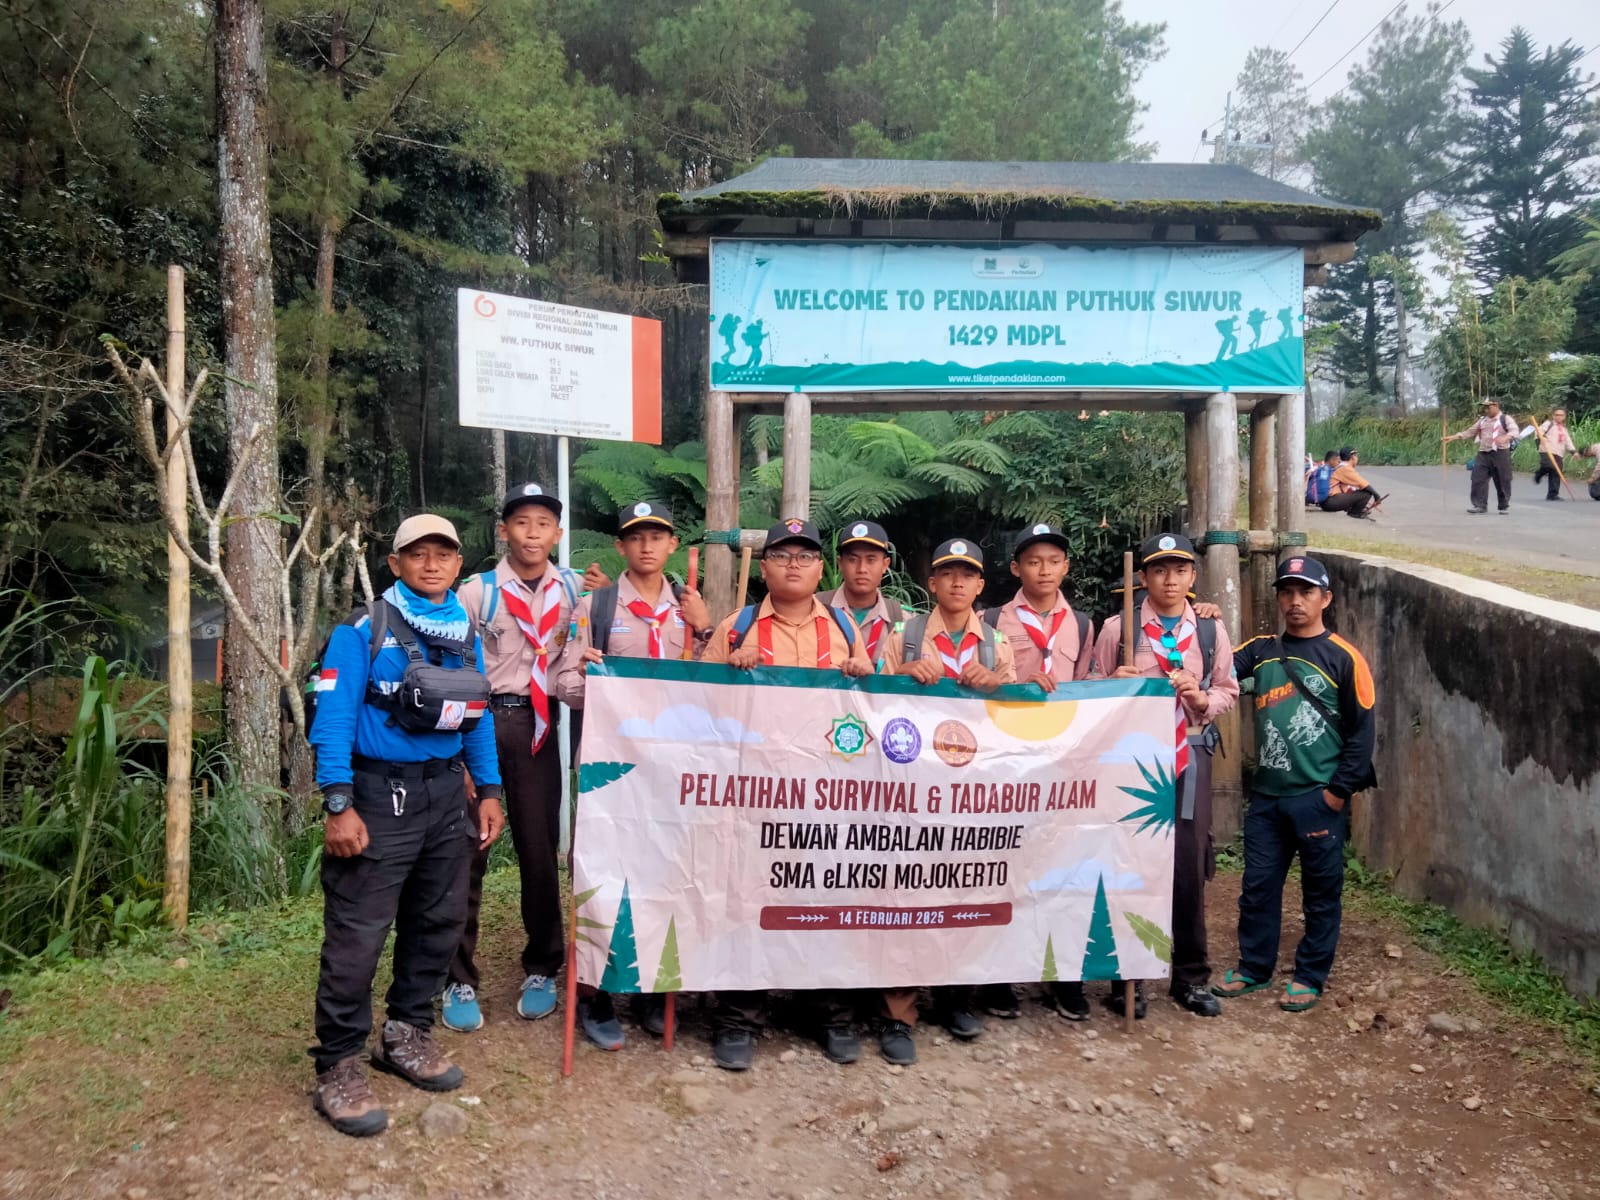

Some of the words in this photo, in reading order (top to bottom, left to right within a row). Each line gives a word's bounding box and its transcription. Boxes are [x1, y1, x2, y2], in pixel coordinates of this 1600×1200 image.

[773, 288, 889, 311] WELCOME
[895, 289, 925, 311] TO
[933, 289, 1057, 312] PENDAKIAN
[1065, 290, 1156, 312] PUTHUK
[1163, 290, 1243, 312] SIWUR
[533, 313, 571, 325] REGIONAL
[573, 319, 594, 329] JAWA
[595, 322, 618, 332] TIMUR
[948, 324, 998, 346] 1429
[1006, 325, 1067, 346] MDPL
[521, 337, 563, 351] PUTHUK
[564, 343, 595, 356] SIWUR
[948, 373, 1066, 385] www.tiketpendakian.com
[679, 773, 807, 810] PELATIHAN
[814, 778, 919, 814] SURVIVAL
[927, 785, 942, 814] &
[950, 783, 1041, 814] TADABUR
[1045, 779, 1097, 811] ALAM
[760, 821, 838, 850] DEWAN
[845, 824, 945, 851] AMBALAN
[950, 825, 1024, 851] HABIBIE
[770, 861, 816, 889] SMA
[823, 862, 888, 889] eLKISI
[893, 861, 1009, 889] MOJOKERTO
[838, 911, 852, 925] 14
[855, 911, 913, 925] FEBRUARI
[915, 910, 945, 925] 2025
